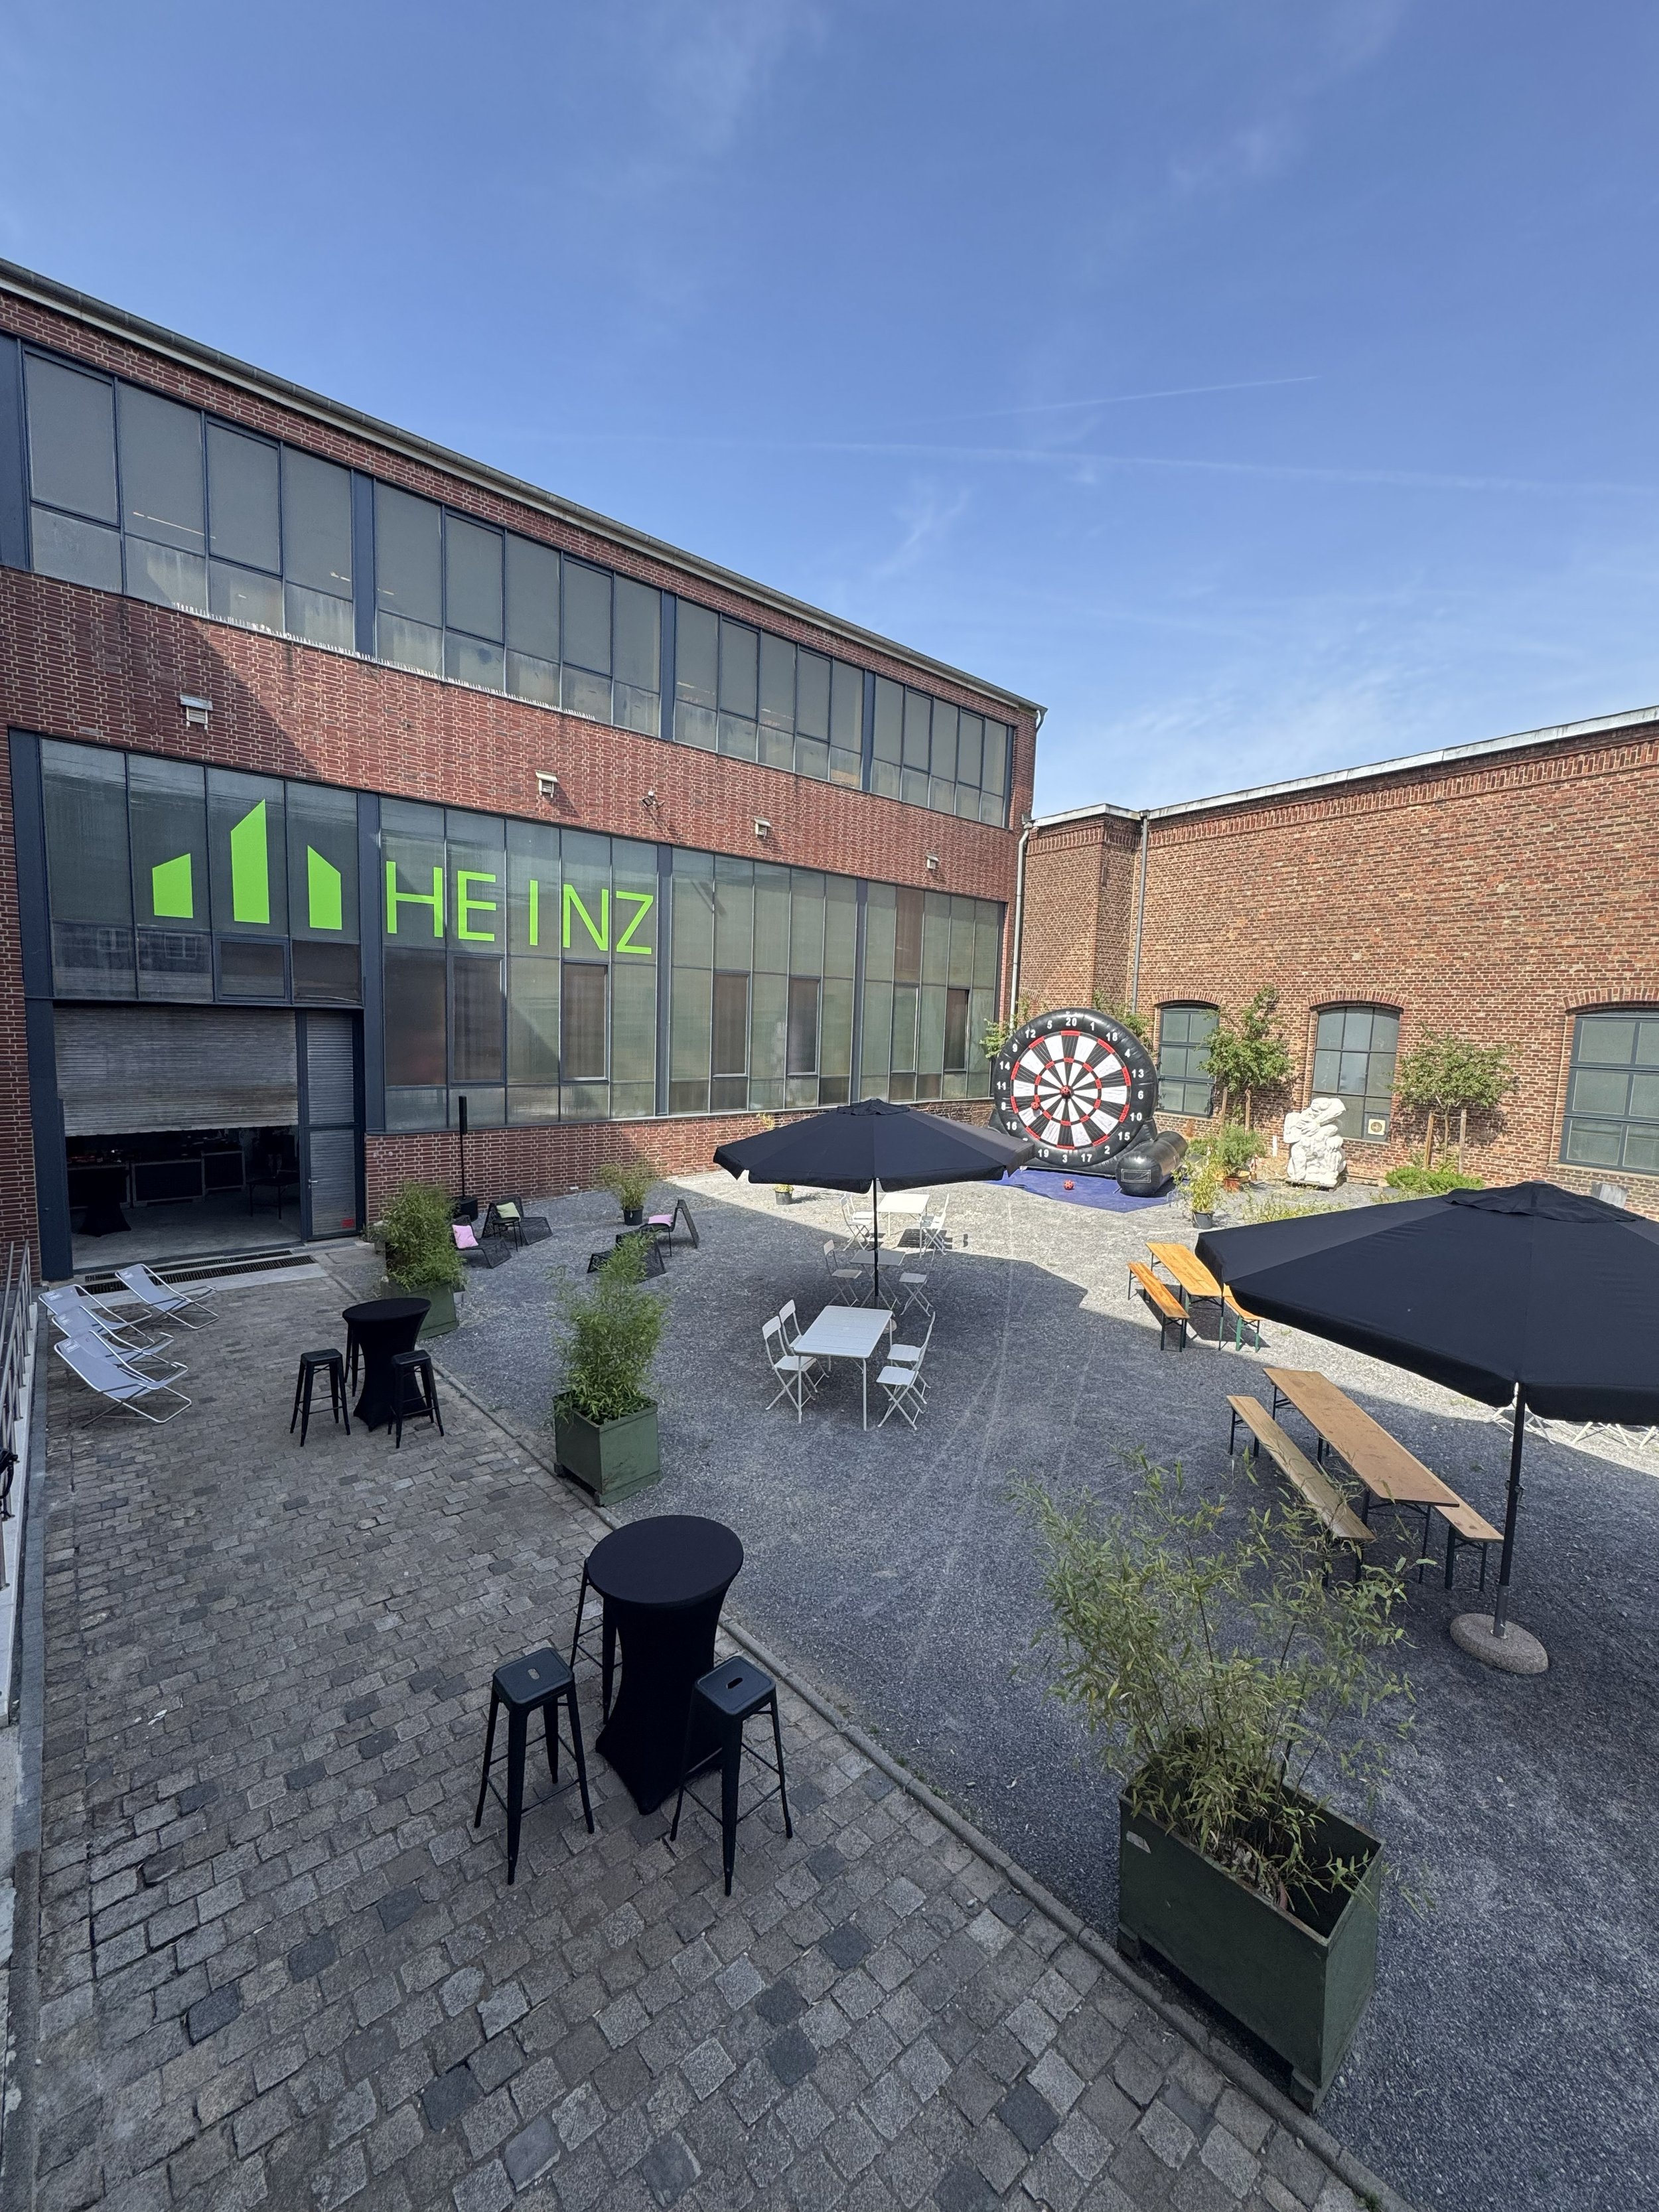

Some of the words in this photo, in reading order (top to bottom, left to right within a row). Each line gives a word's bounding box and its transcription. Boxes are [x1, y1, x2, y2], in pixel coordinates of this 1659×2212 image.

[387, 861, 652, 954] HEINZ
[1046, 1019, 1053, 1029] 5
[1064, 1016, 1078, 1027] 20
[1090, 1021, 1096, 1032] 1
[1025, 1028, 1037, 1039] 12
[1106, 1031, 1118, 1042] 18
[1012, 1043, 1018, 1053] 9
[1124, 1048, 1131, 1058] 4
[999, 1061, 1011, 1070] 14
[1131, 1069, 1145, 1078] 13
[996, 1081, 1007, 1090] 11
[1137, 1090, 1144, 1100] 6
[1001, 1102, 1007, 1111] 8
[1129, 1112, 1143, 1122] 10
[1006, 1121, 1017, 1131] 16
[1118, 1131, 1130, 1141] 15
[1037, 1149, 1049, 1159] 19
[1104, 1145, 1110, 1155] 2
[1062, 1153, 1068, 1163] 3
[1080, 1153, 1092, 1163] 17
